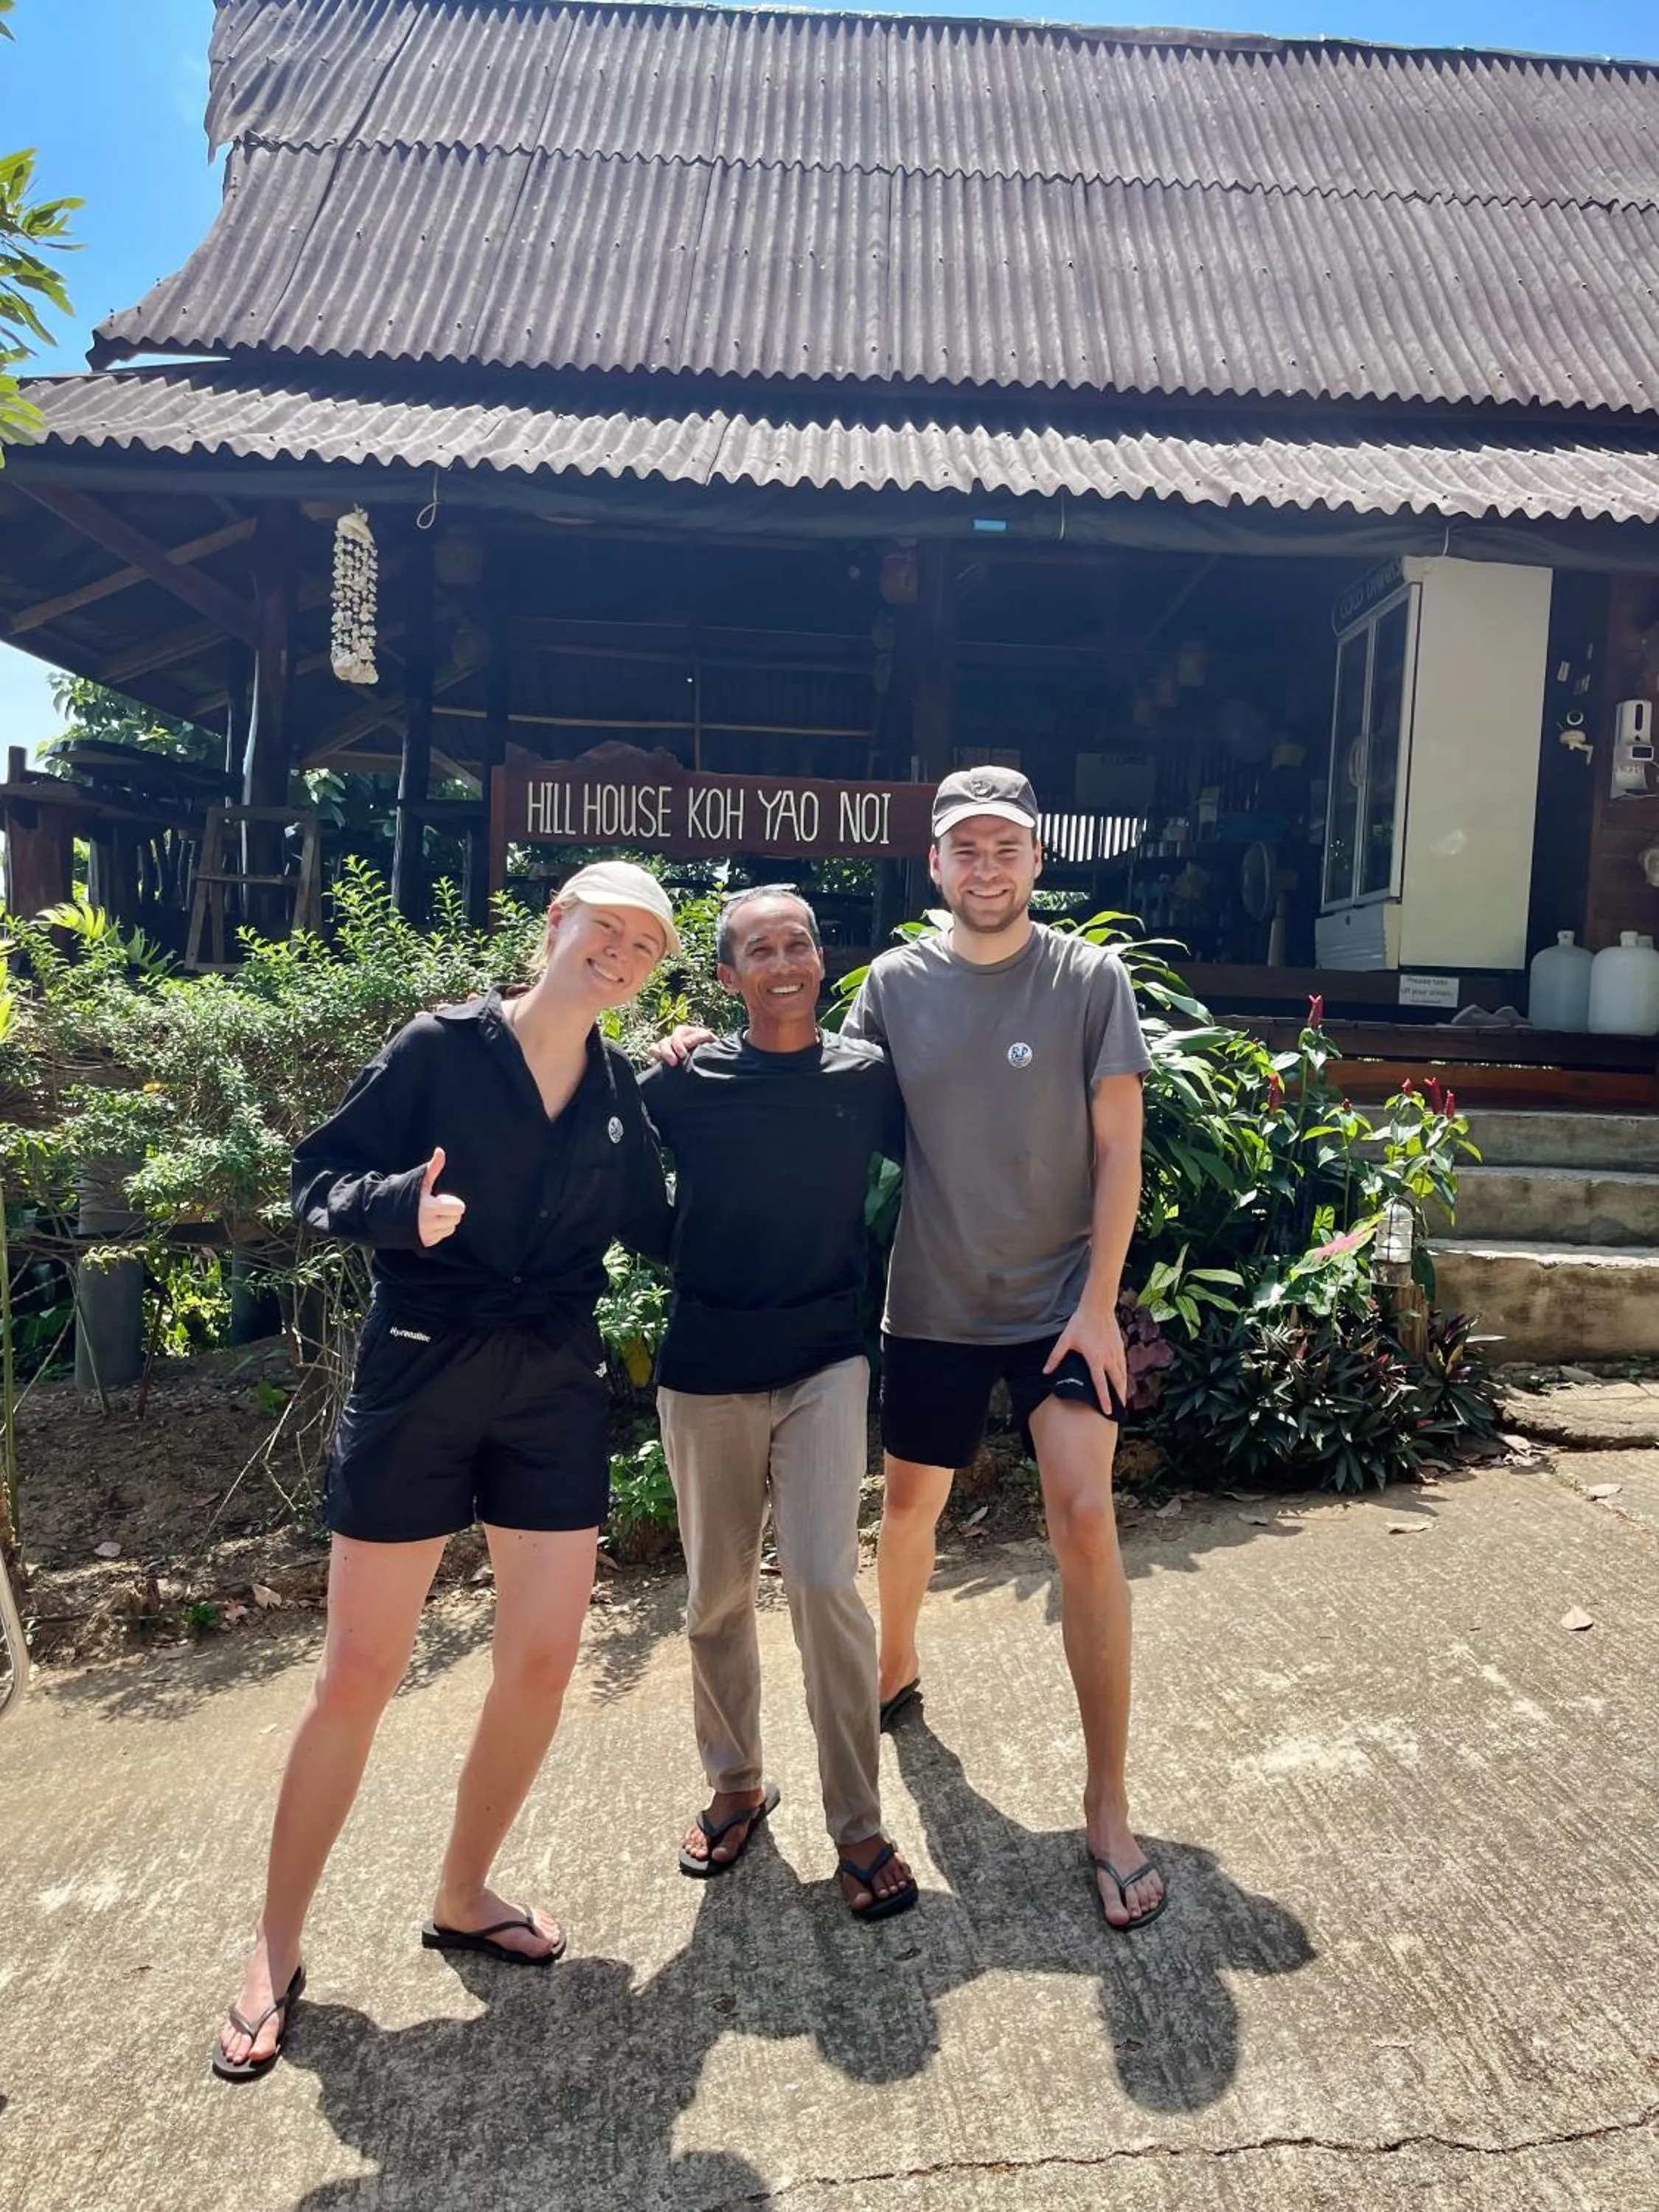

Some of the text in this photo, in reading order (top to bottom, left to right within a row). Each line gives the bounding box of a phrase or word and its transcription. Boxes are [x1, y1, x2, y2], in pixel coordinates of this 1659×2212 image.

[527, 782, 891, 844] HILL HOUSE KOH YAO NOI
